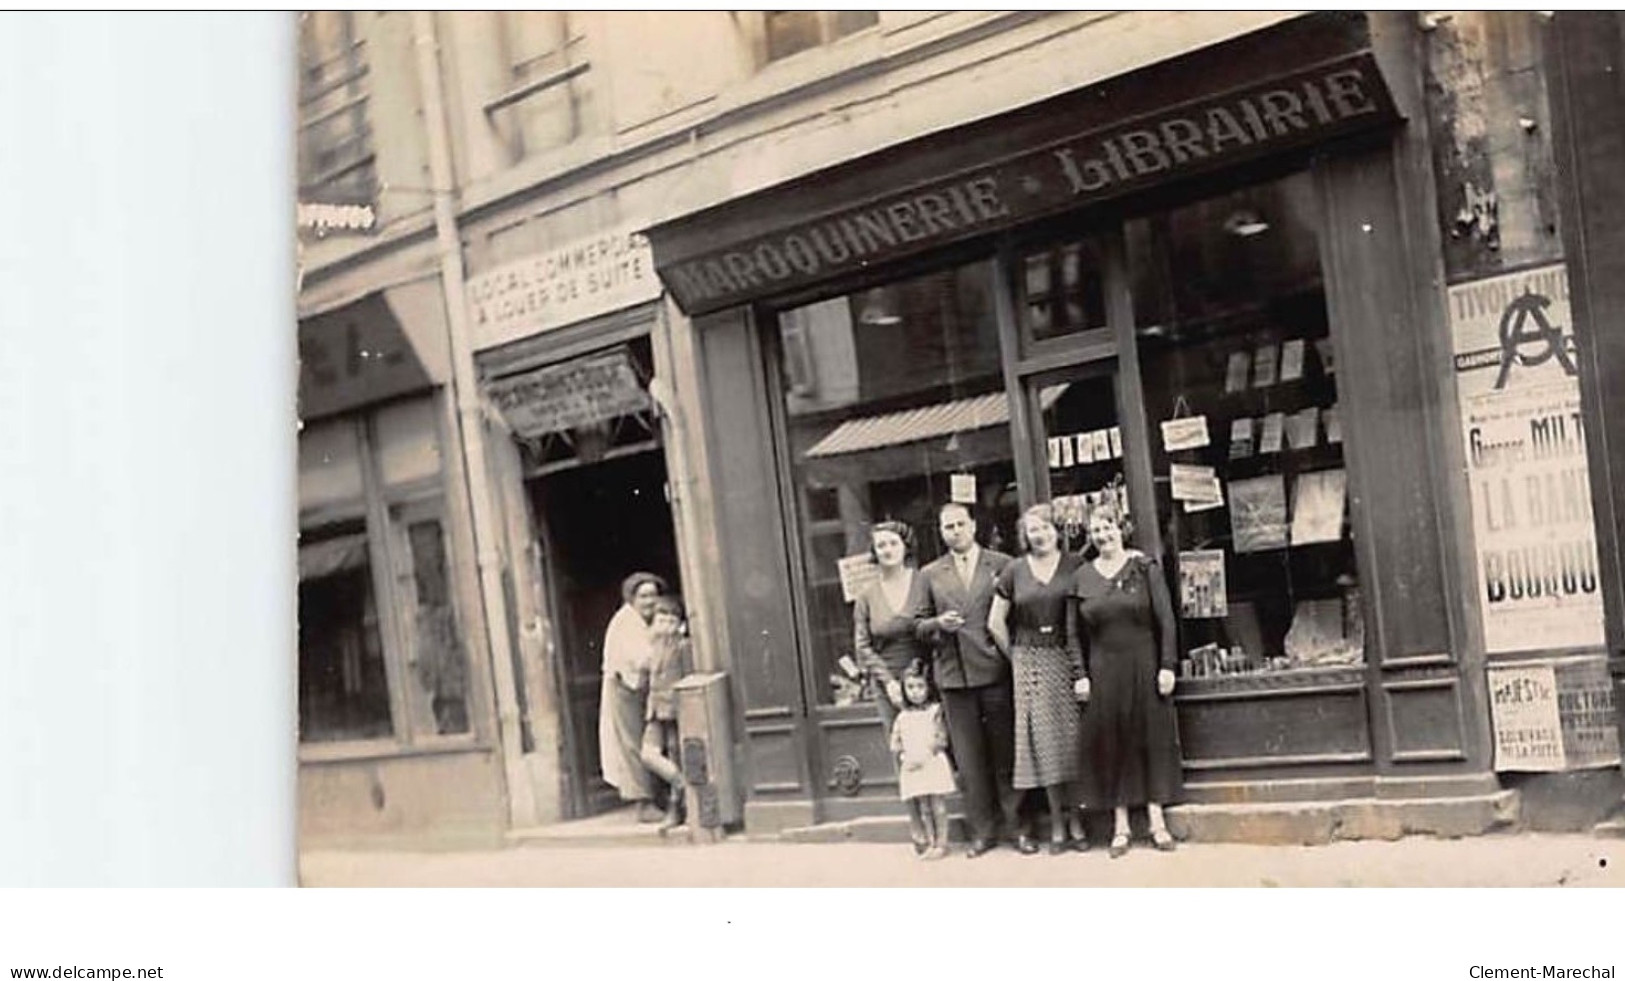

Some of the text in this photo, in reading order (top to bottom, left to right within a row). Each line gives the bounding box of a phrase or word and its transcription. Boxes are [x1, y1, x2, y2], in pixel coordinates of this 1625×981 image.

[670, 69, 1377, 300] MAROQUINERIE LIBRAIRIE
[473, 268, 531, 304] LOCAL
[555, 277, 580, 303] DE
[588, 257, 643, 294] SUITE
[1482, 477, 1517, 532] LA
